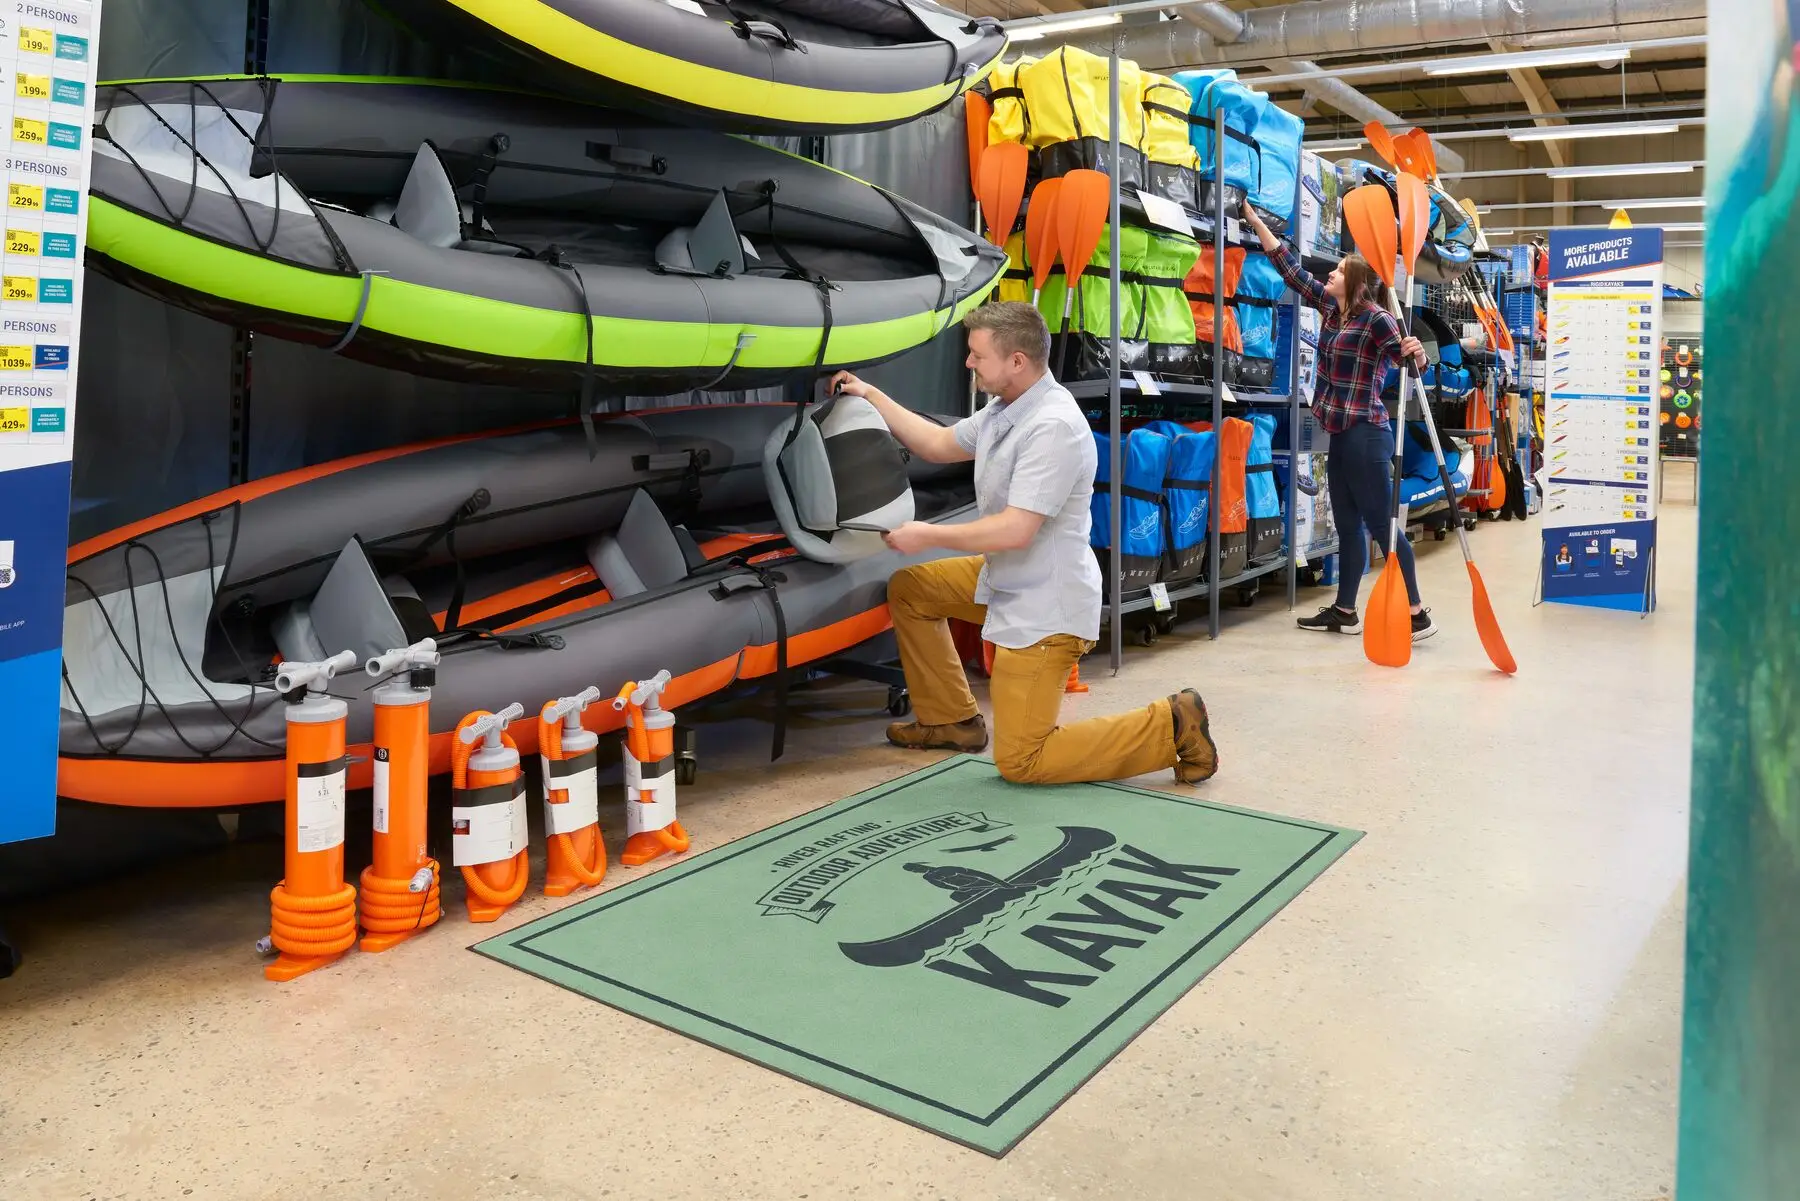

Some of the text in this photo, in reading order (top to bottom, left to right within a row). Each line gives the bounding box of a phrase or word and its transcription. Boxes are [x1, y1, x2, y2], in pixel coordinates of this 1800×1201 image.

[17, 3, 78, 24] 2 PERSONS
[5, 158, 68, 176] 3 PERSONS
[1564, 236, 1633, 257] MORE PRODUCTS
[1566, 248, 1629, 269] AVAILABLE
[4, 320, 56, 333] PERSONS
[0, 386, 53, 397] PERSONS
[773, 822, 882, 869] RIVER RAFTING
[770, 816, 971, 905] OUTDOOR ADVENTURE
[924, 843, 1241, 1009] KAYAK
